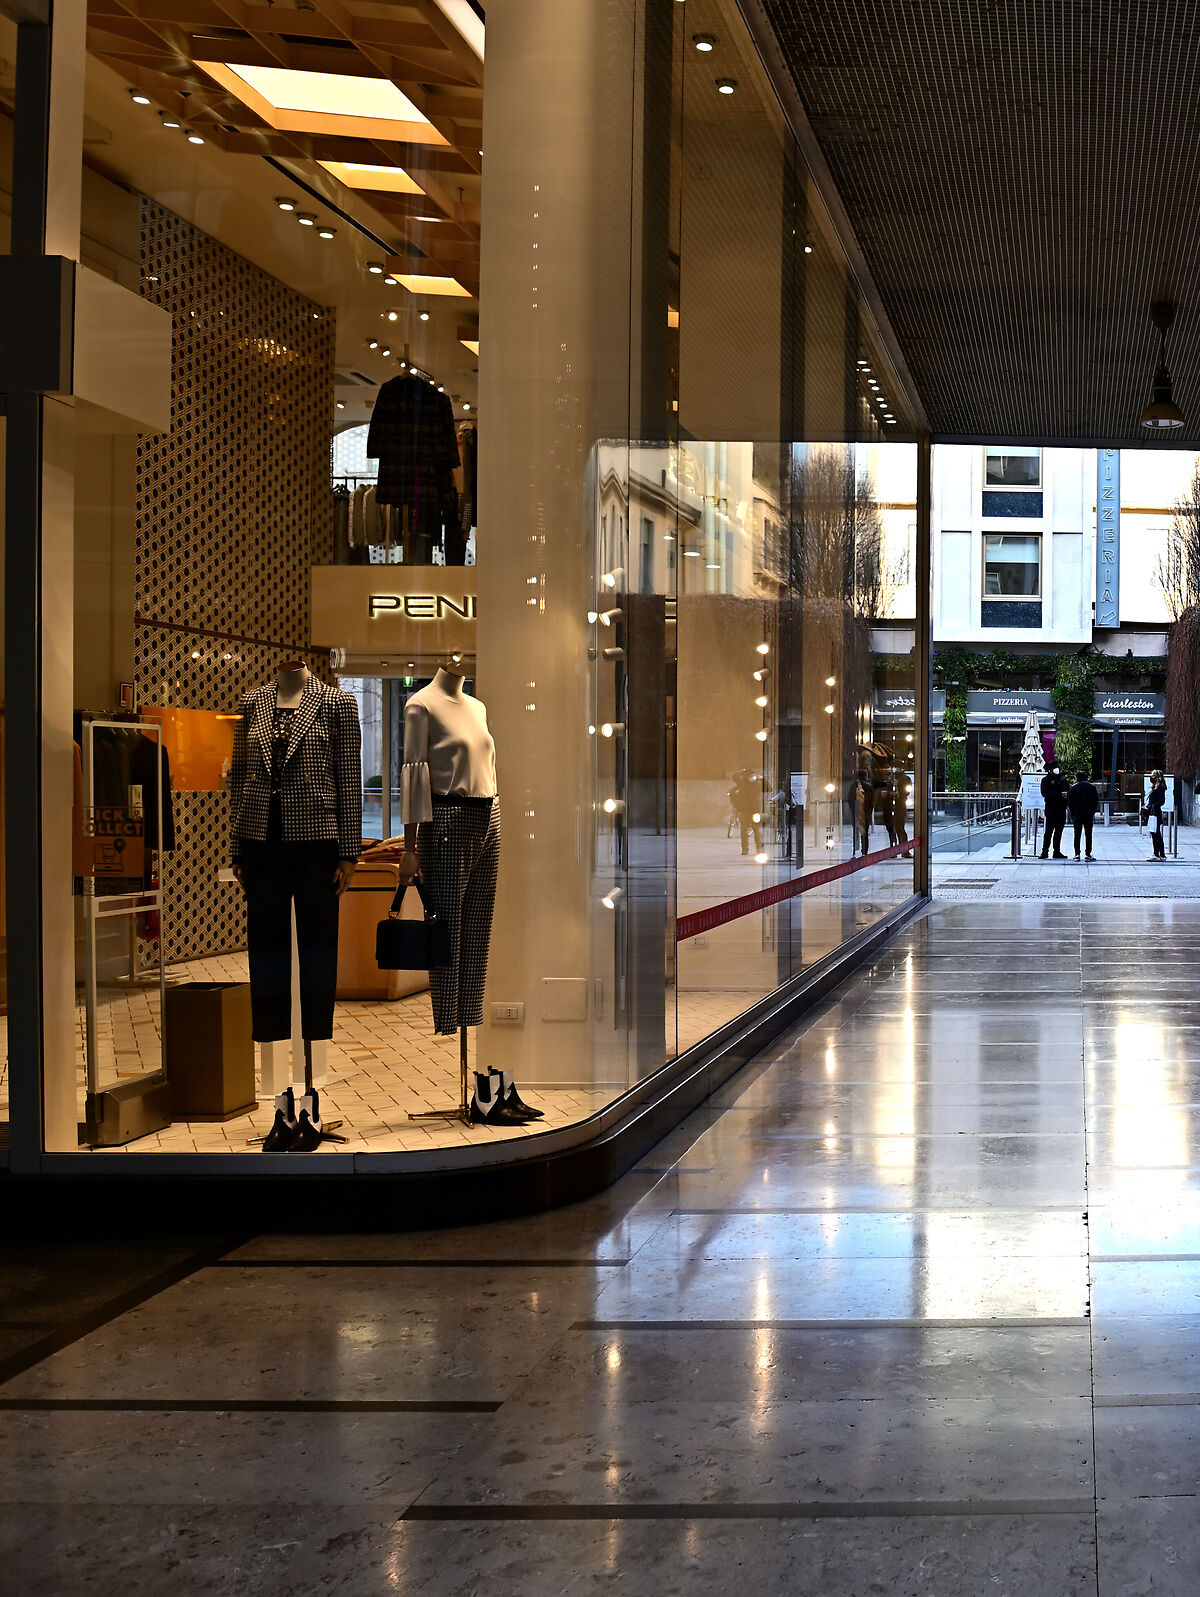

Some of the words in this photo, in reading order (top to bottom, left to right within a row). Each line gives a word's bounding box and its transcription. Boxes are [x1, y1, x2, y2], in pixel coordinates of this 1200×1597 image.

[1102, 449, 1115, 603] PIZZERIA
[368, 595, 477, 618] PEN
[993, 698, 1029, 706] PIZZERIA
[1102, 698, 1155, 709] charleston
